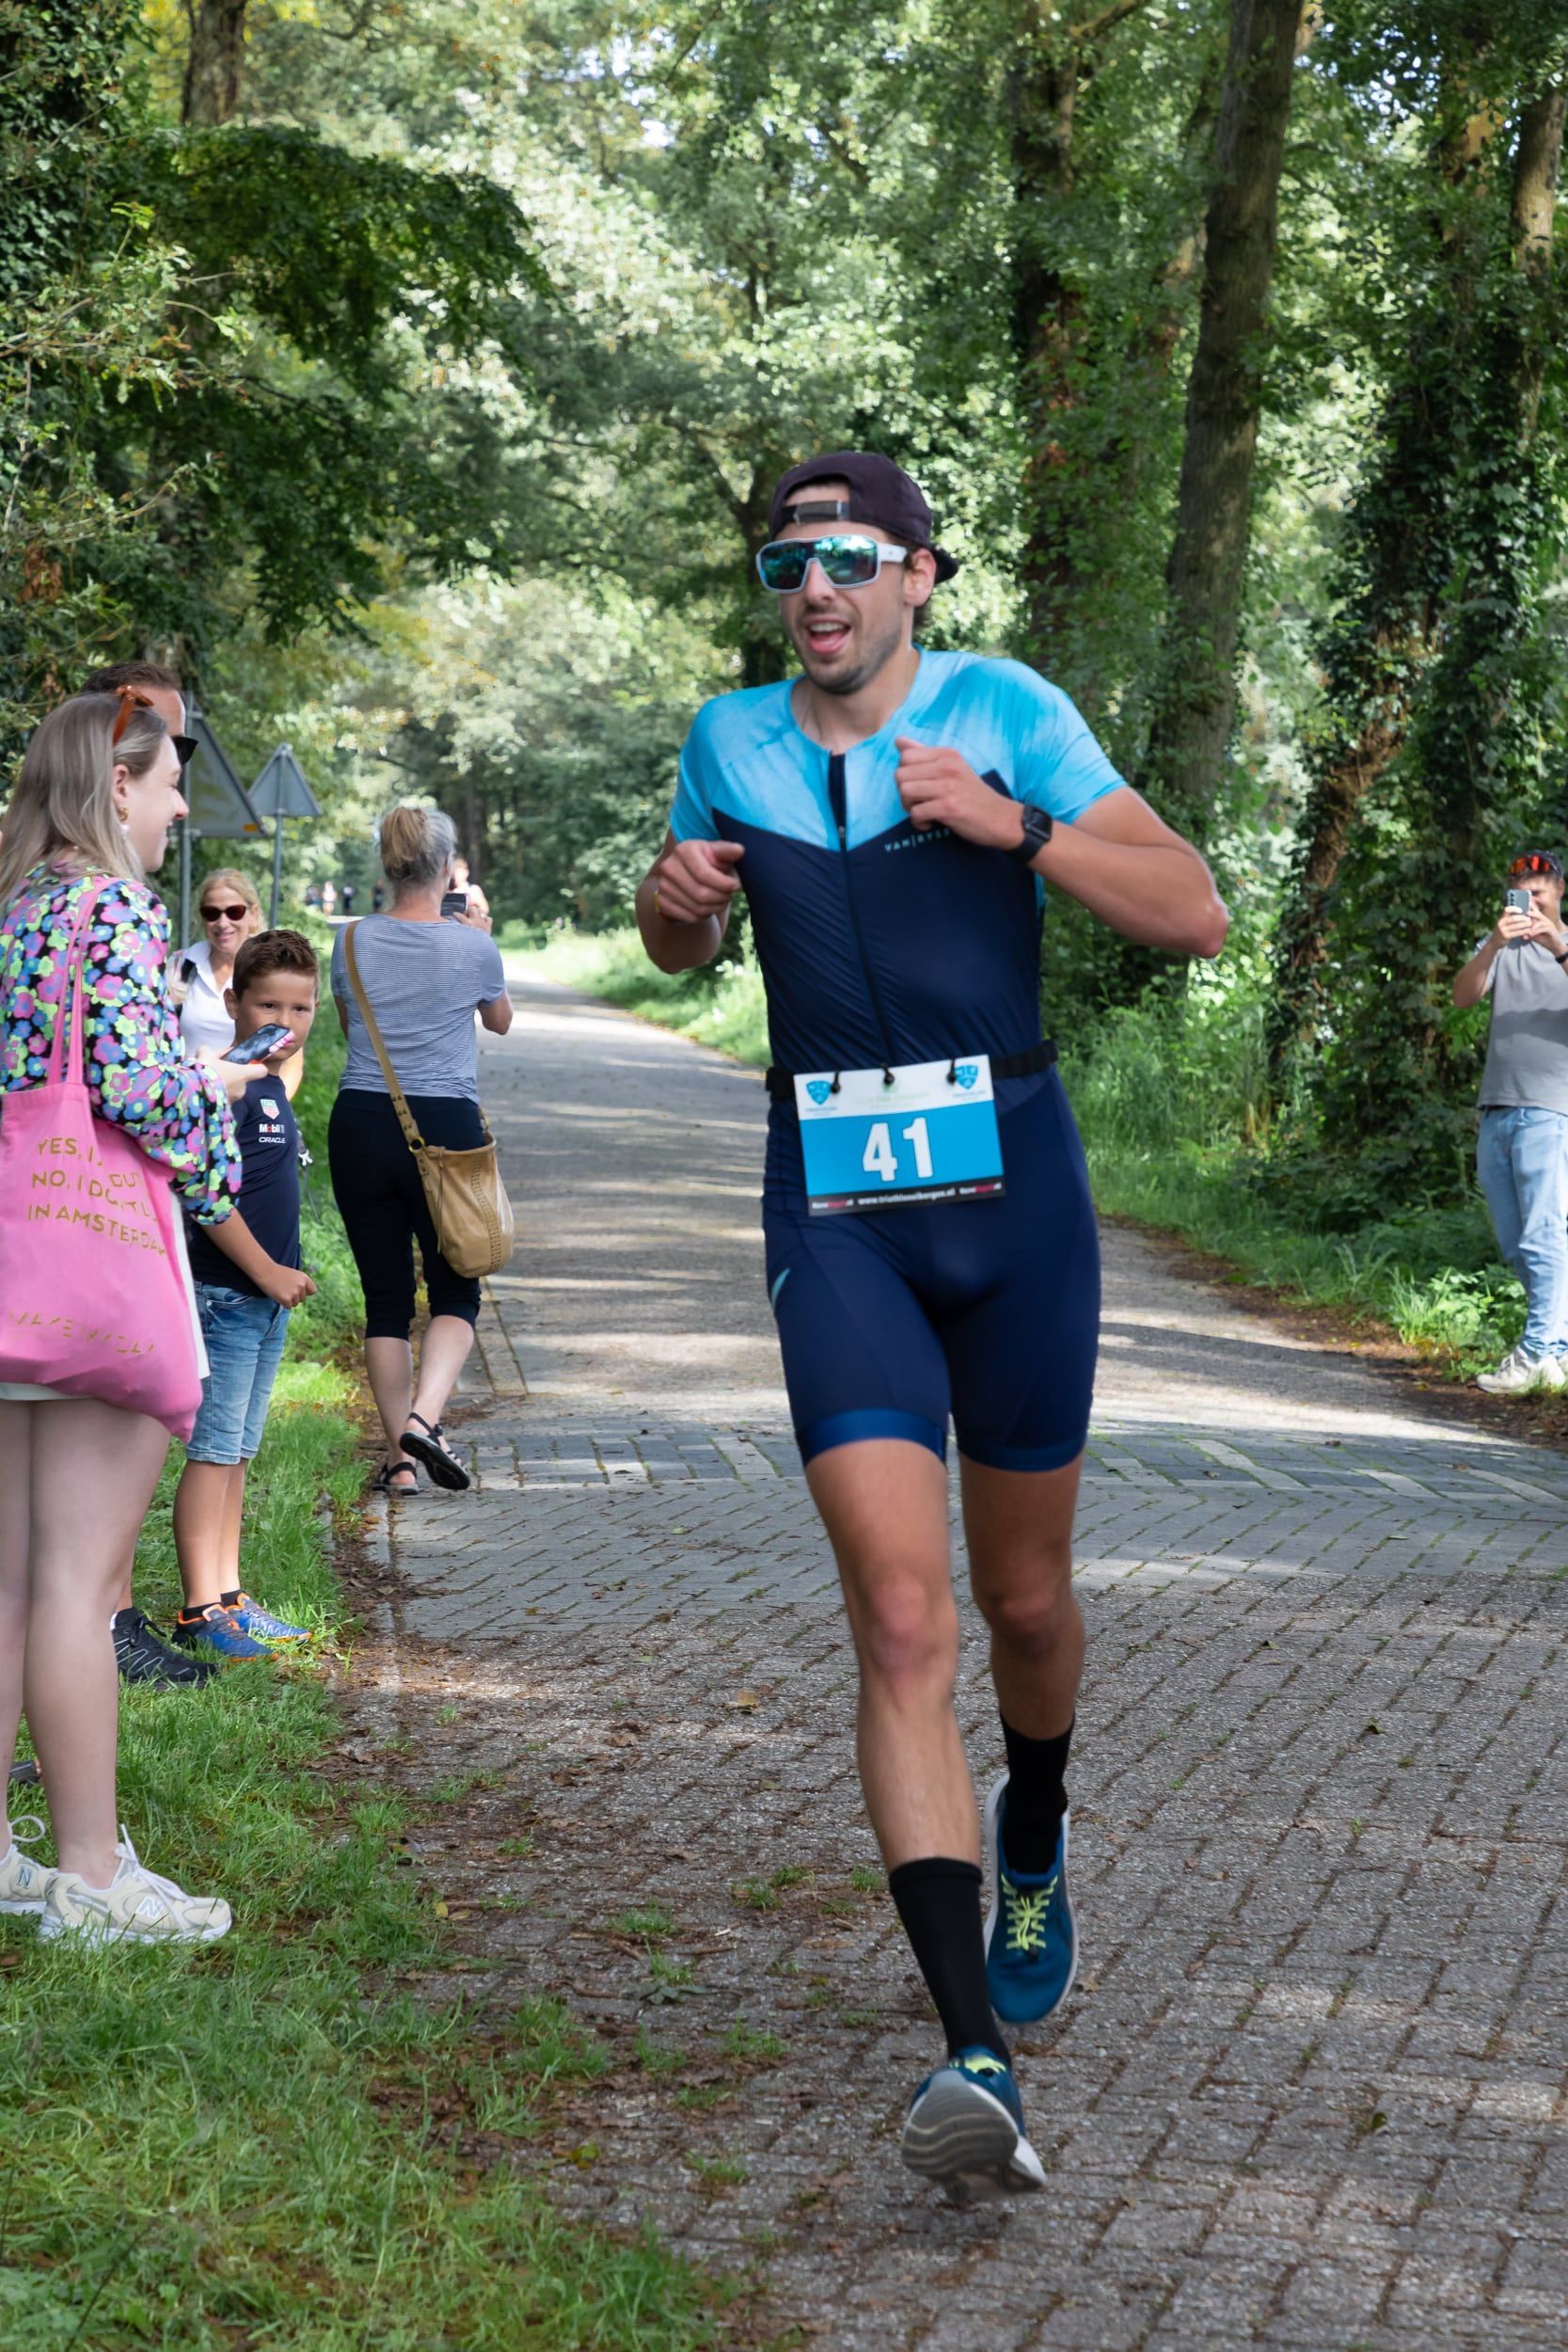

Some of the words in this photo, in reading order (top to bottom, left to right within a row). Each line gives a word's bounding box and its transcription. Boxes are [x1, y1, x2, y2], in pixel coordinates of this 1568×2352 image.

[38, 1137, 82, 1160] YES,
[863, 1117, 933, 1182] 41
[32, 1170, 71, 1190] NO,
[77, 1175, 83, 1191] I
[27, 1203, 51, 1221] IN
